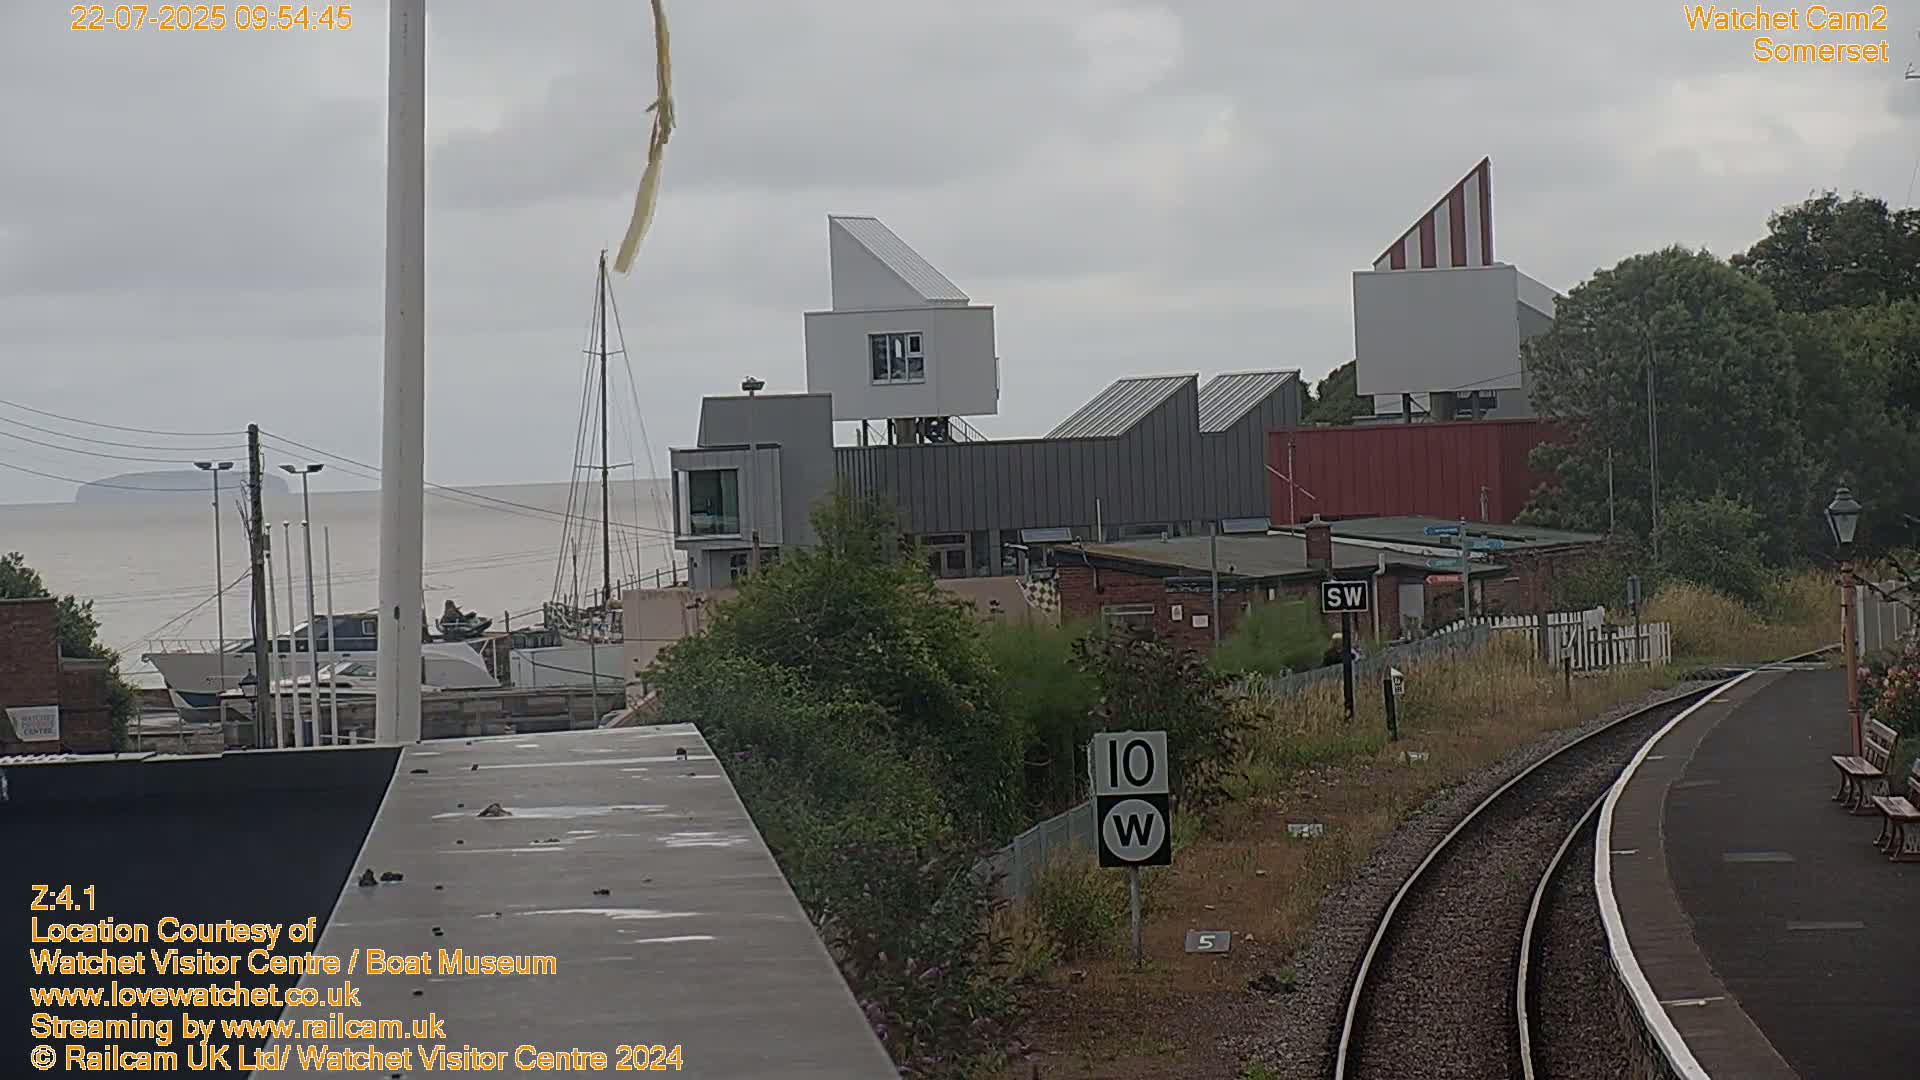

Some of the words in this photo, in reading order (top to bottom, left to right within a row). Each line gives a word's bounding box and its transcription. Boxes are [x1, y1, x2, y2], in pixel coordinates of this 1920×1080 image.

[1327, 586, 1362, 607] SW
[1109, 739, 1155, 788] 10
[1112, 813, 1155, 847] W
[1198, 935, 1216, 949] 5
